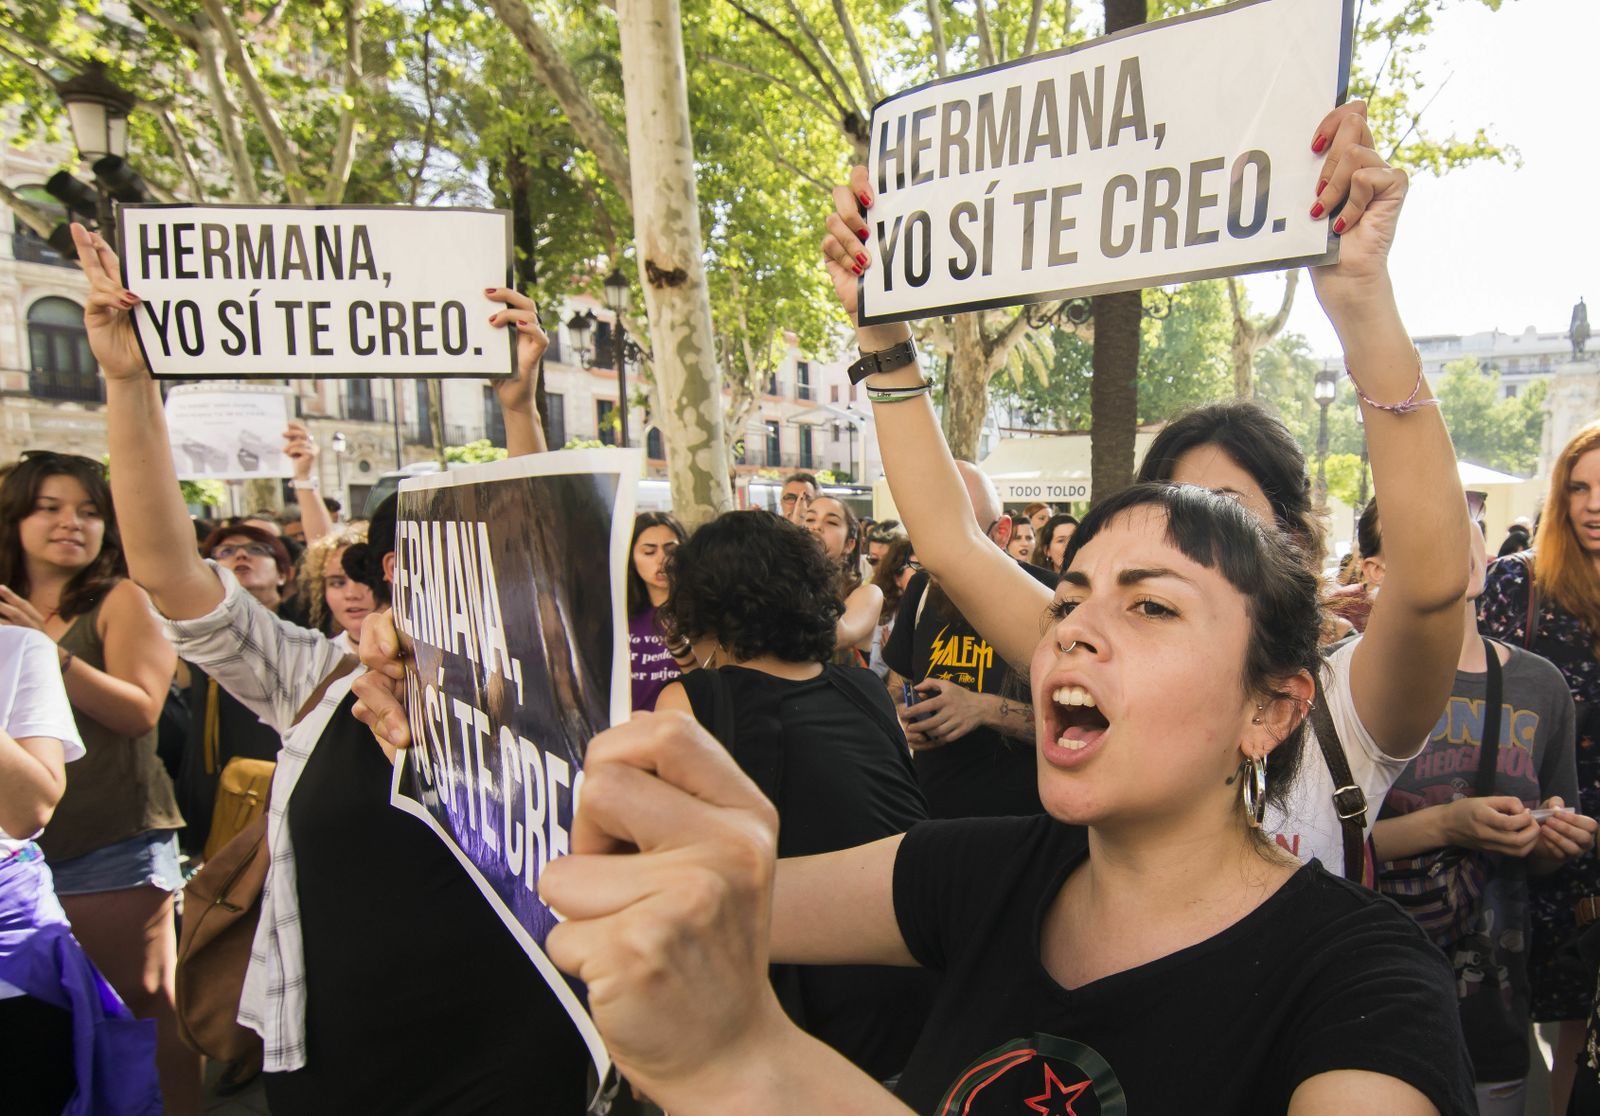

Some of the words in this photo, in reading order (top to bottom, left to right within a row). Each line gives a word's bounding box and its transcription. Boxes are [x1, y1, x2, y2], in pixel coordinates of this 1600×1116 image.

[879, 56, 1166, 195] HERMANA,
[139, 222, 393, 289] HERMANA,
[876, 210, 932, 293] YO
[948, 180, 998, 281] SÍ
[1013, 183, 1083, 271] TE
[1099, 149, 1287, 259] CREO.
[142, 300, 206, 357] YO
[217, 288, 262, 357] SÍ
[275, 300, 335, 356] TE
[349, 299, 483, 357] CREO.
[1009, 486, 1042, 497] TODO
[1046, 485, 1087, 497] TOLDO
[1430, 696, 1540, 753] NIC
[425, 666, 458, 815] SÍ
[453, 697, 498, 852] TE
[499, 724, 585, 924] CRE
